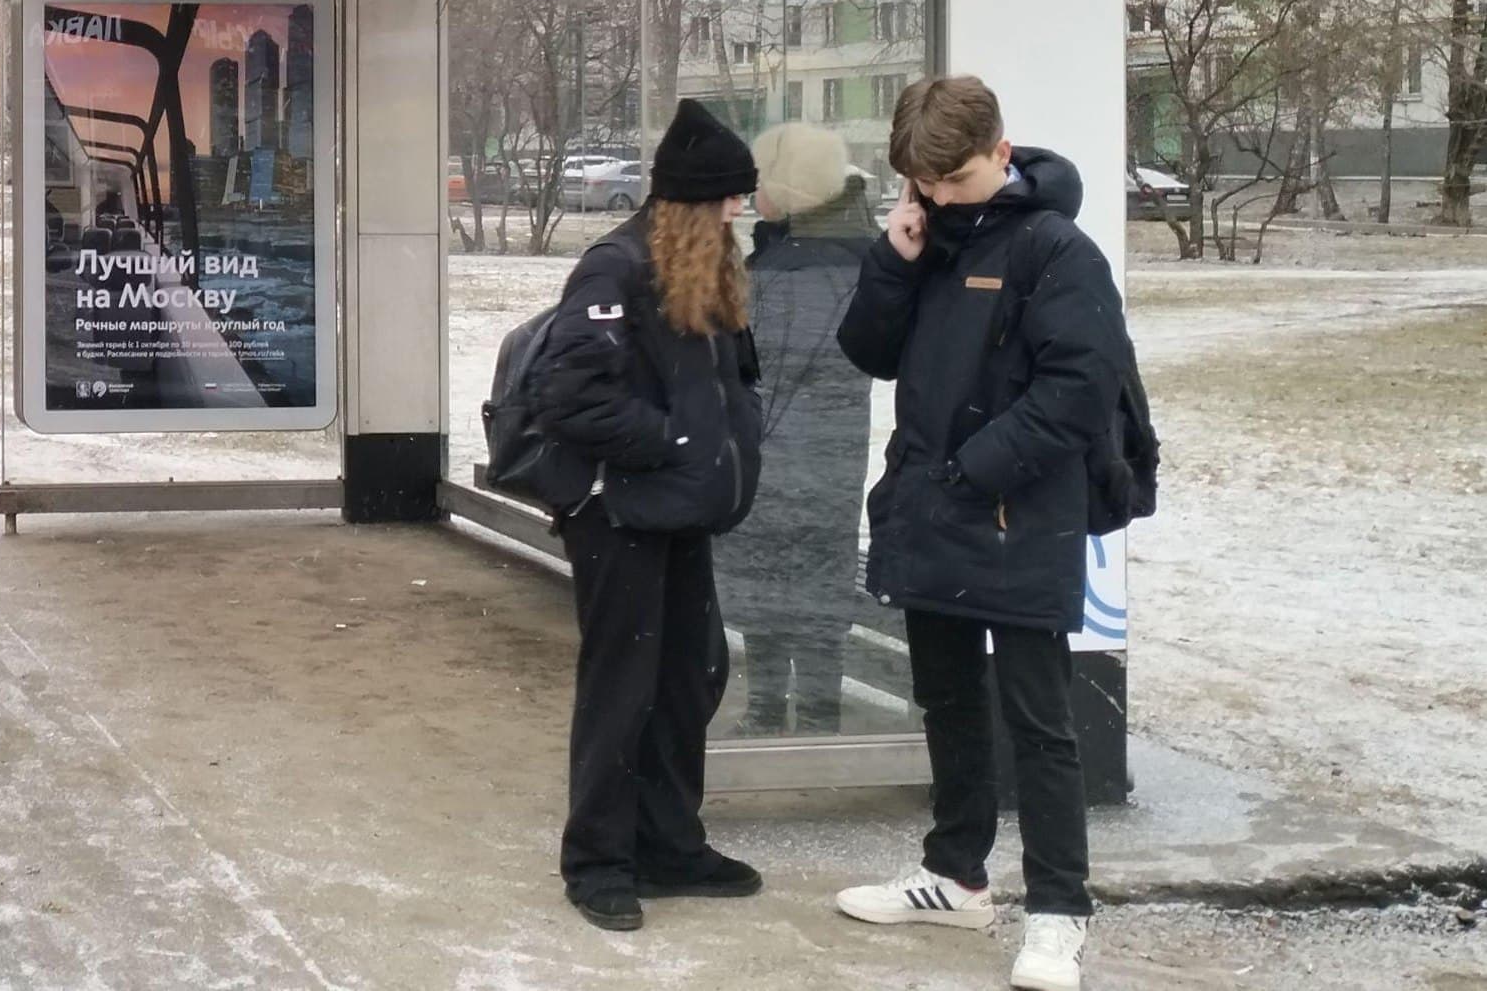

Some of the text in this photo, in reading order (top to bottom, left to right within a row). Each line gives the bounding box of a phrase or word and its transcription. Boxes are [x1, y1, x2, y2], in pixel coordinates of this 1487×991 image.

[75, 249, 259, 281] Лучший вид
[76, 283, 237, 314] на Москву
[75, 318, 286, 333] Речные маршруты круглый год
